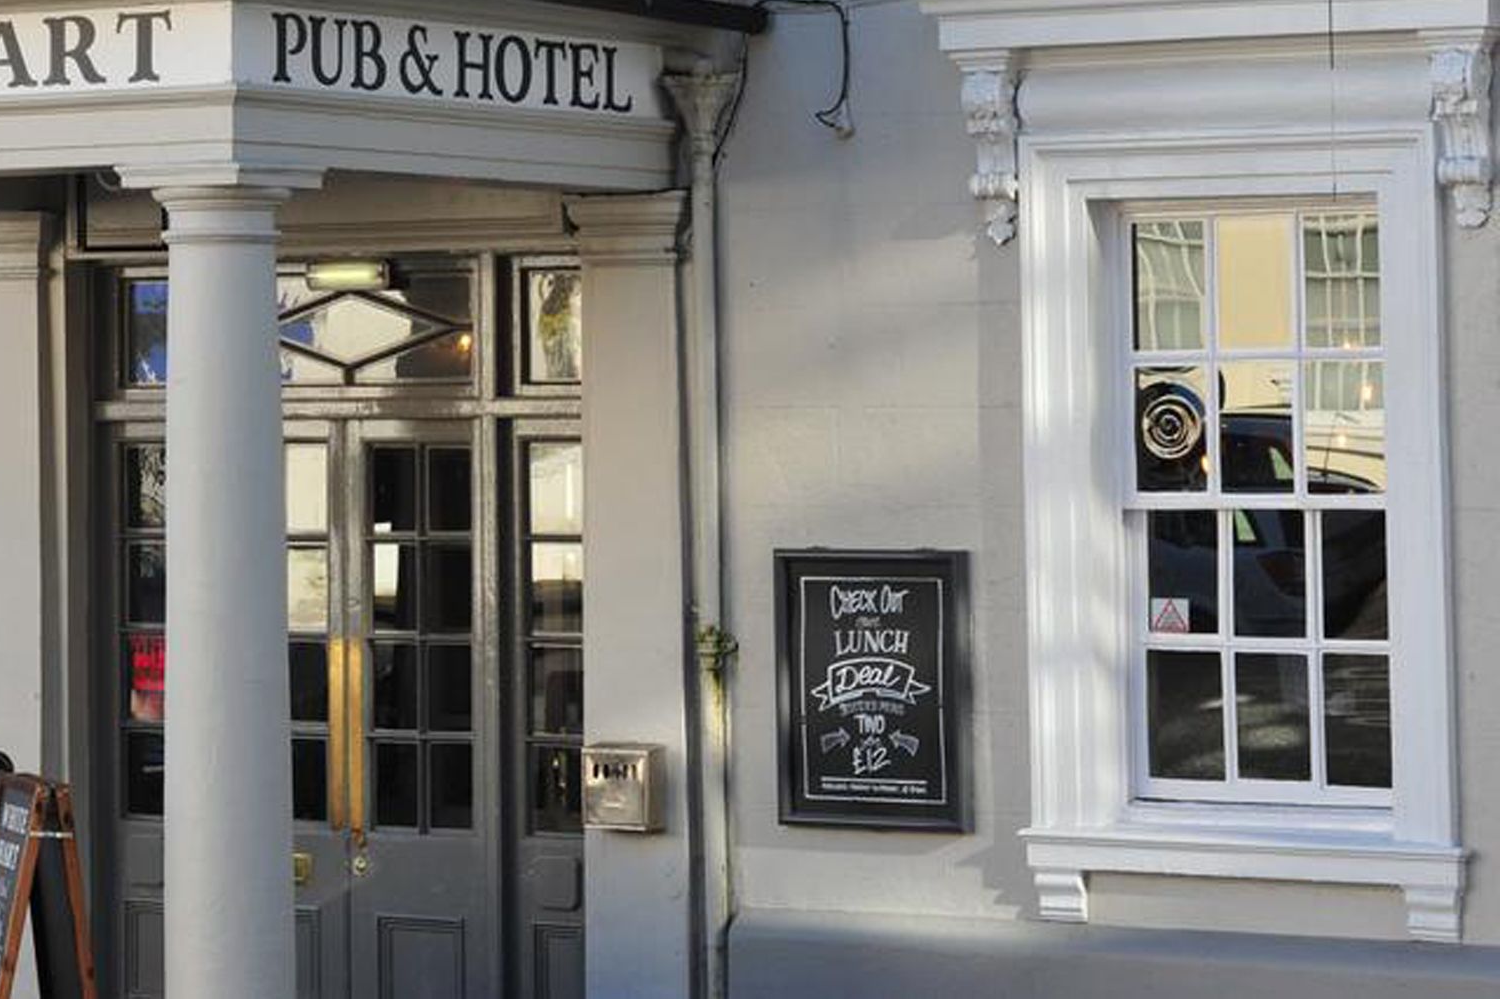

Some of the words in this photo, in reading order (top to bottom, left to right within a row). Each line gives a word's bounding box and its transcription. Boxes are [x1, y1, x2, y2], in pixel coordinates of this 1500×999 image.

[272, 12, 387, 91] PUB
[453, 31, 632, 113] HOTEL
[834, 630, 910, 657] LUNCH
[835, 664, 901, 693] Deal
[852, 747, 892, 775] £12
